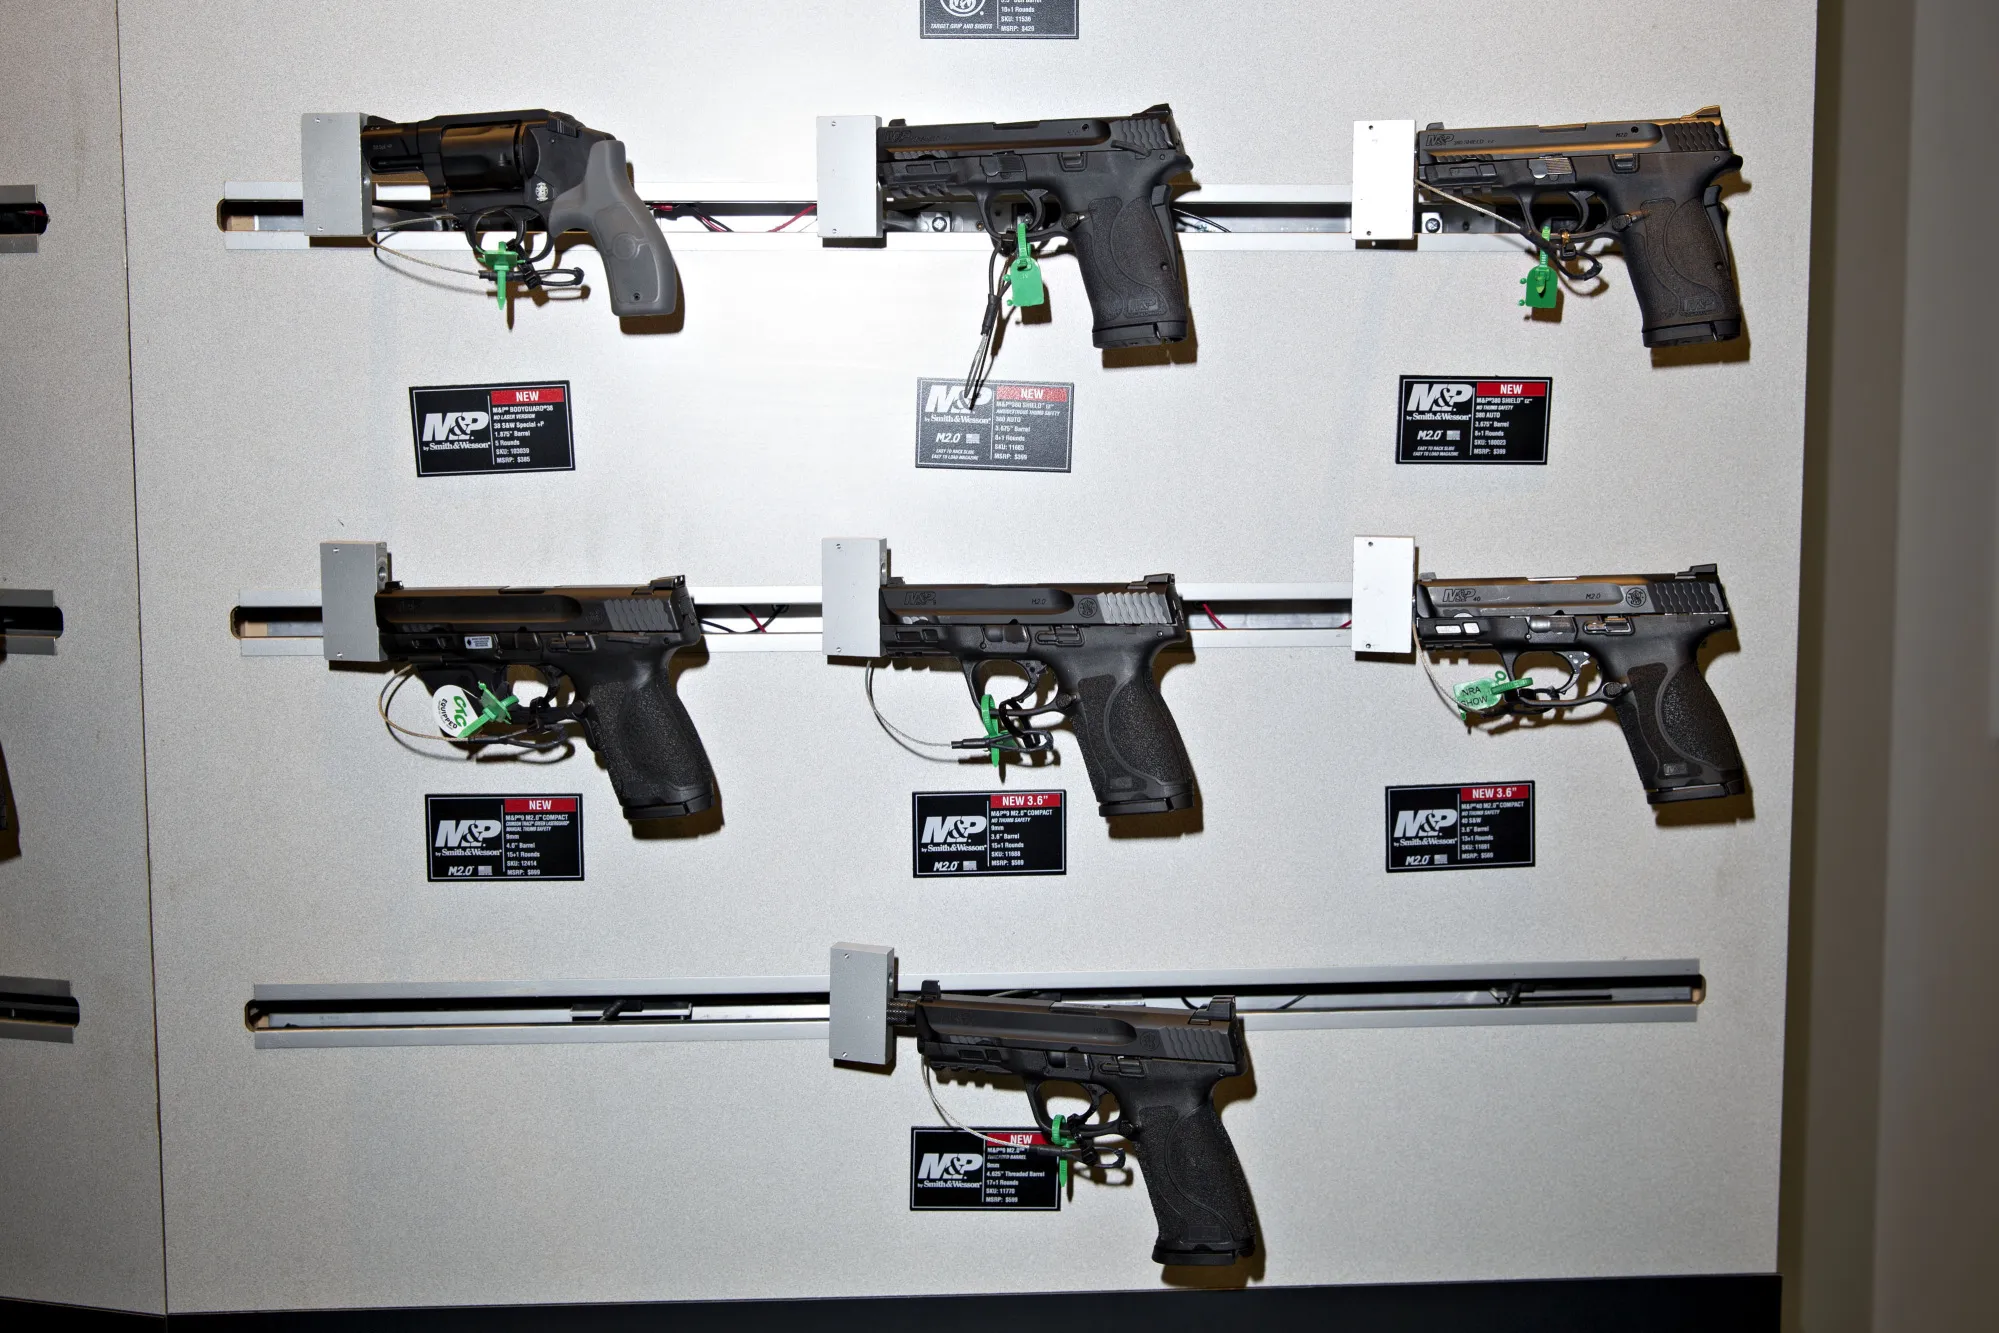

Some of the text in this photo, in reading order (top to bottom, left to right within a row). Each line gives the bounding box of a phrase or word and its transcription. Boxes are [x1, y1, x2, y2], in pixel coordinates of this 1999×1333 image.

[1020, 389, 1044, 398] NEW
[1500, 384, 1522, 394] NEW
[516, 391, 538, 402] NEW
[1406, 384, 1473, 412] M&P
[1412, 412, 1472, 420] Smith&Wesson
[422, 412, 489, 442] M&P
[1417, 430, 1442, 440] M2.0
[430, 441, 491, 450] Smith&Wesson
[1442, 588, 1476, 602] M&P
[1461, 686, 1482, 696] NRA
[1460, 696, 1488, 706] SHOW
[440, 698, 458, 729] EQUIPPED
[454, 696, 468, 728] CTC
[1472, 789, 1494, 798] NEW
[529, 800, 552, 810] NEW
[1002, 796, 1024, 806] NEW
[1394, 809, 1458, 837] M&P
[435, 820, 502, 847] M&P
[921, 816, 987, 844] M&P
[1400, 838, 1458, 846] Smith&Wesson
[928, 844, 987, 852] Smith&Wesson
[934, 861, 958, 870] M2.0
[1406, 856, 1430, 866] M2.0
[448, 866, 473, 876] M2.0
[1010, 1134, 1032, 1144] NEW
[918, 1153, 983, 1180] M&P
[924, 1180, 982, 1188] Smith&Wesson
